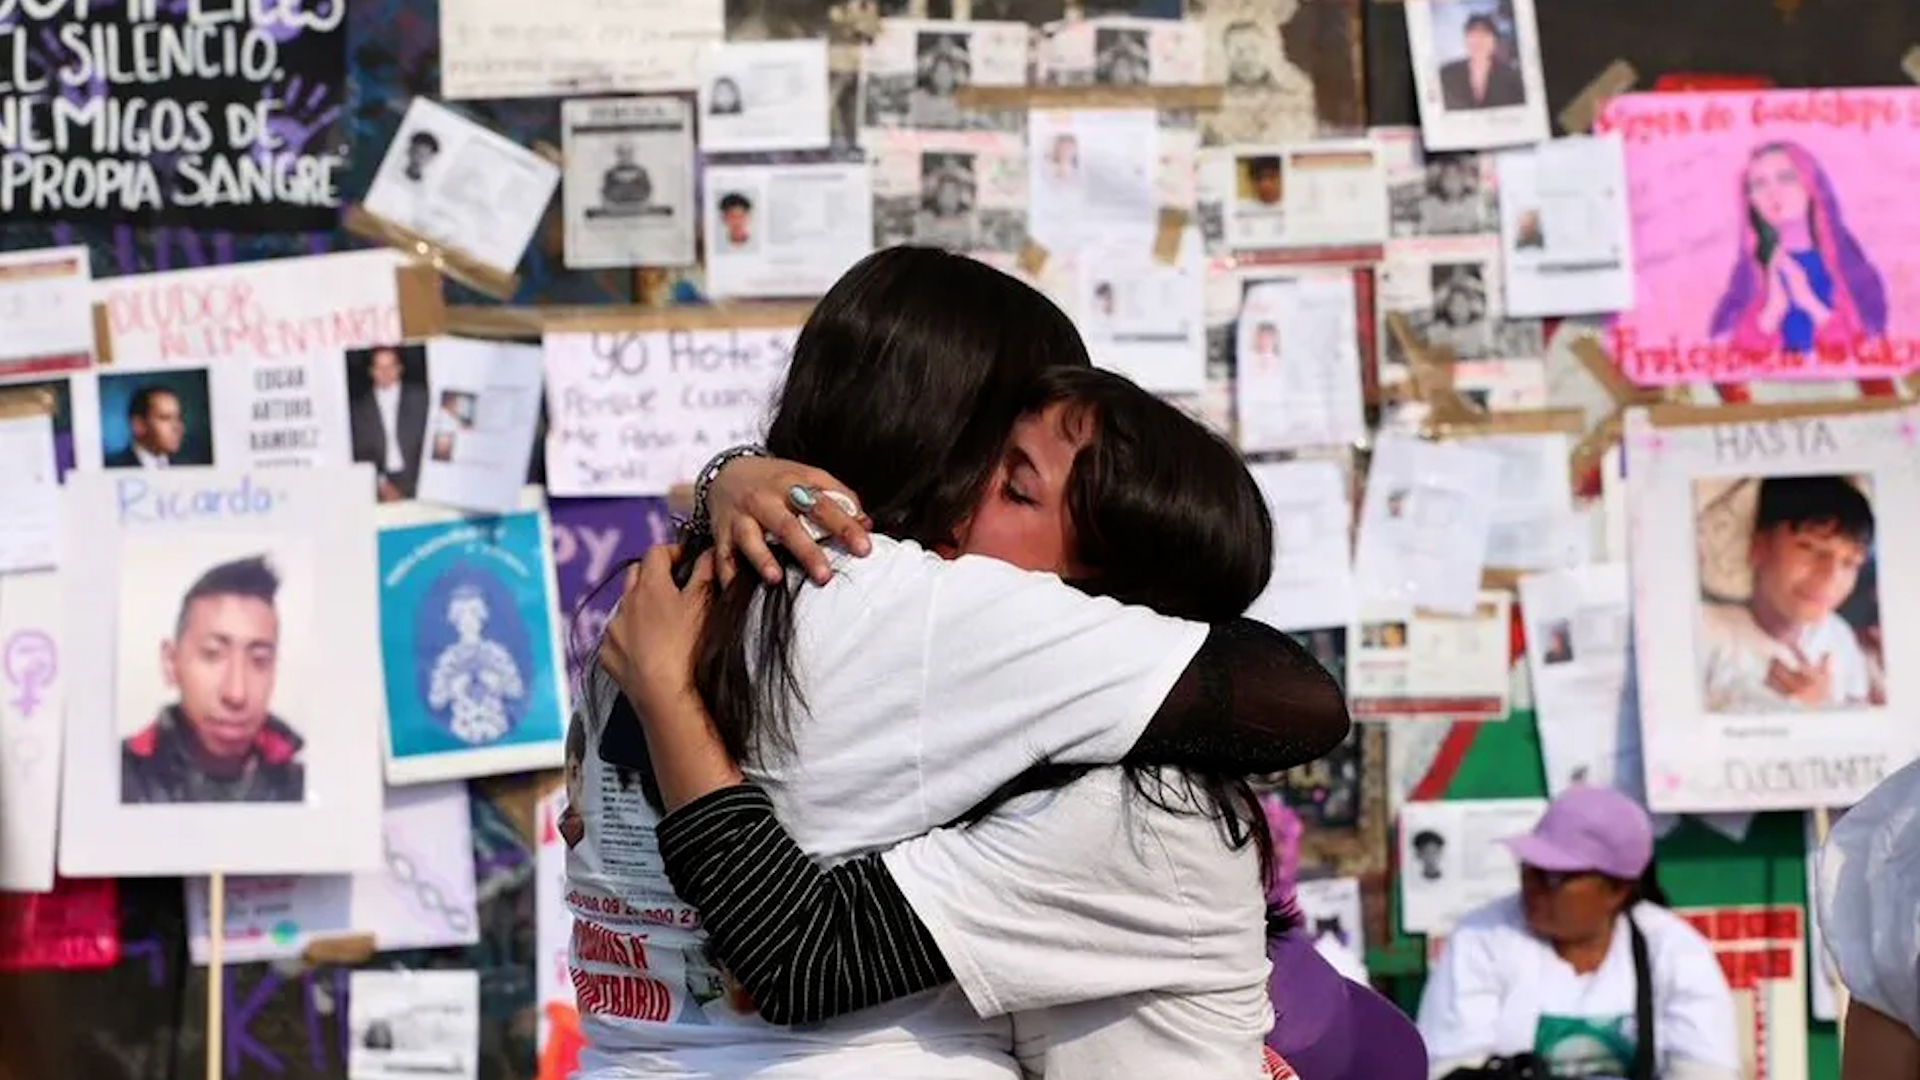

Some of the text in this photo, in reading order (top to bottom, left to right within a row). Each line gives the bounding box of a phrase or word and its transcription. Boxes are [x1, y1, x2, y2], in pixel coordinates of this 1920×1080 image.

[59, 22, 284, 86] SILENCIO.
[225, 99, 284, 150] DE
[2, 153, 343, 211] PROPIA SANGRE
